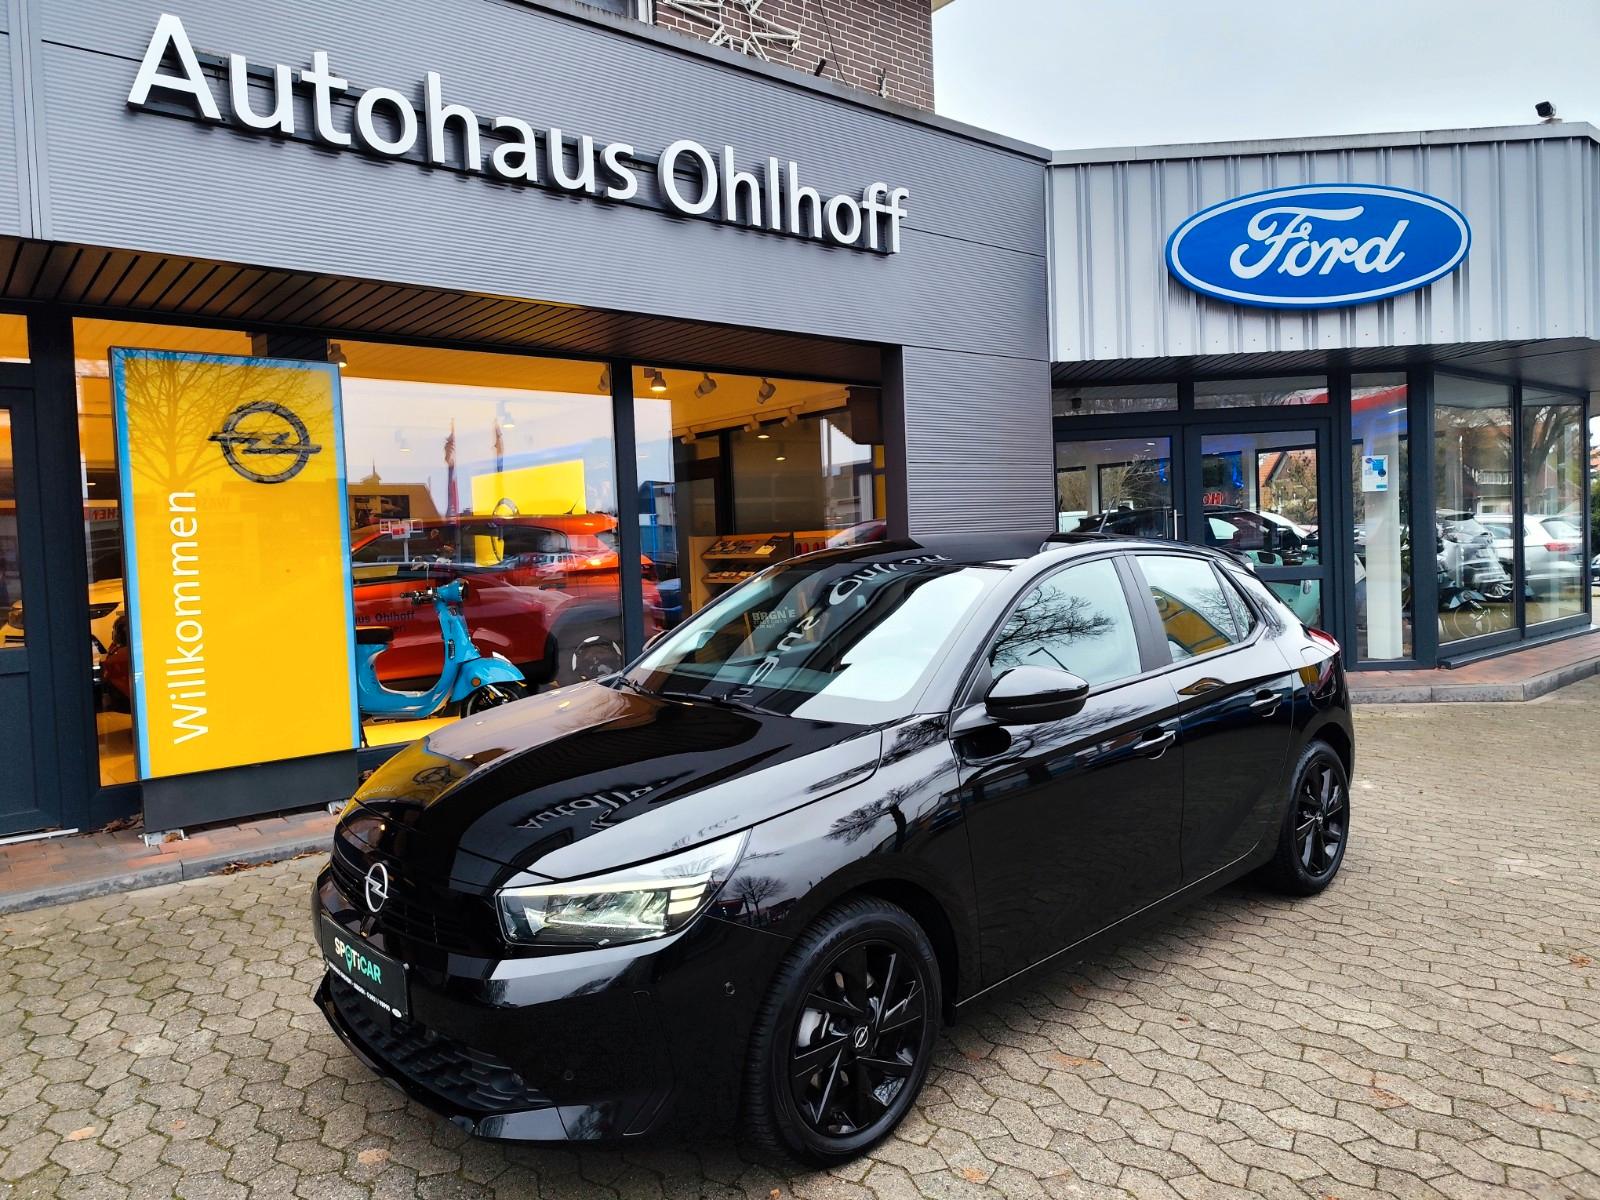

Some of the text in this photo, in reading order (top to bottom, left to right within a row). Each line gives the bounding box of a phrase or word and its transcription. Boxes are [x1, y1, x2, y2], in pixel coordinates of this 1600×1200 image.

[127, 13, 909, 255] Autohaus Ohlhoff
[1229, 205, 1410, 280] Ford
[166, 490, 209, 745] Willkommen
